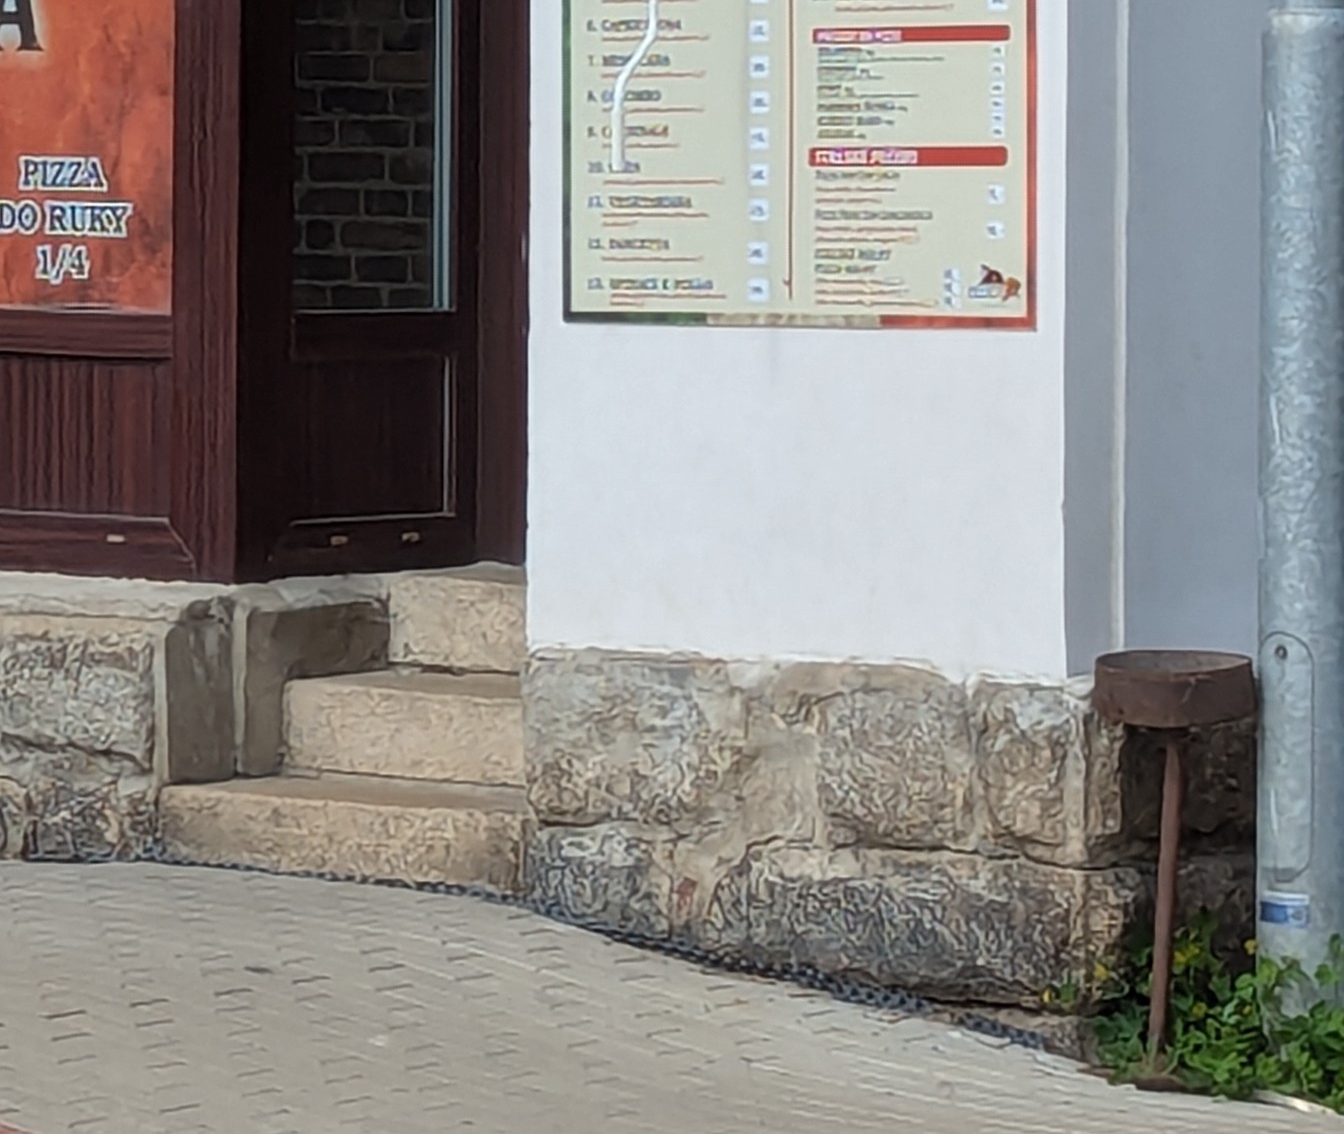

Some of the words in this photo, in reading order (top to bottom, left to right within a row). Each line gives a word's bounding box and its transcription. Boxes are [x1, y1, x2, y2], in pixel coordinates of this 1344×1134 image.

[20, 156, 107, 191] PIZZA
[45, 201, 132, 237] RUKY
[36, 244, 90, 284] 1/4
